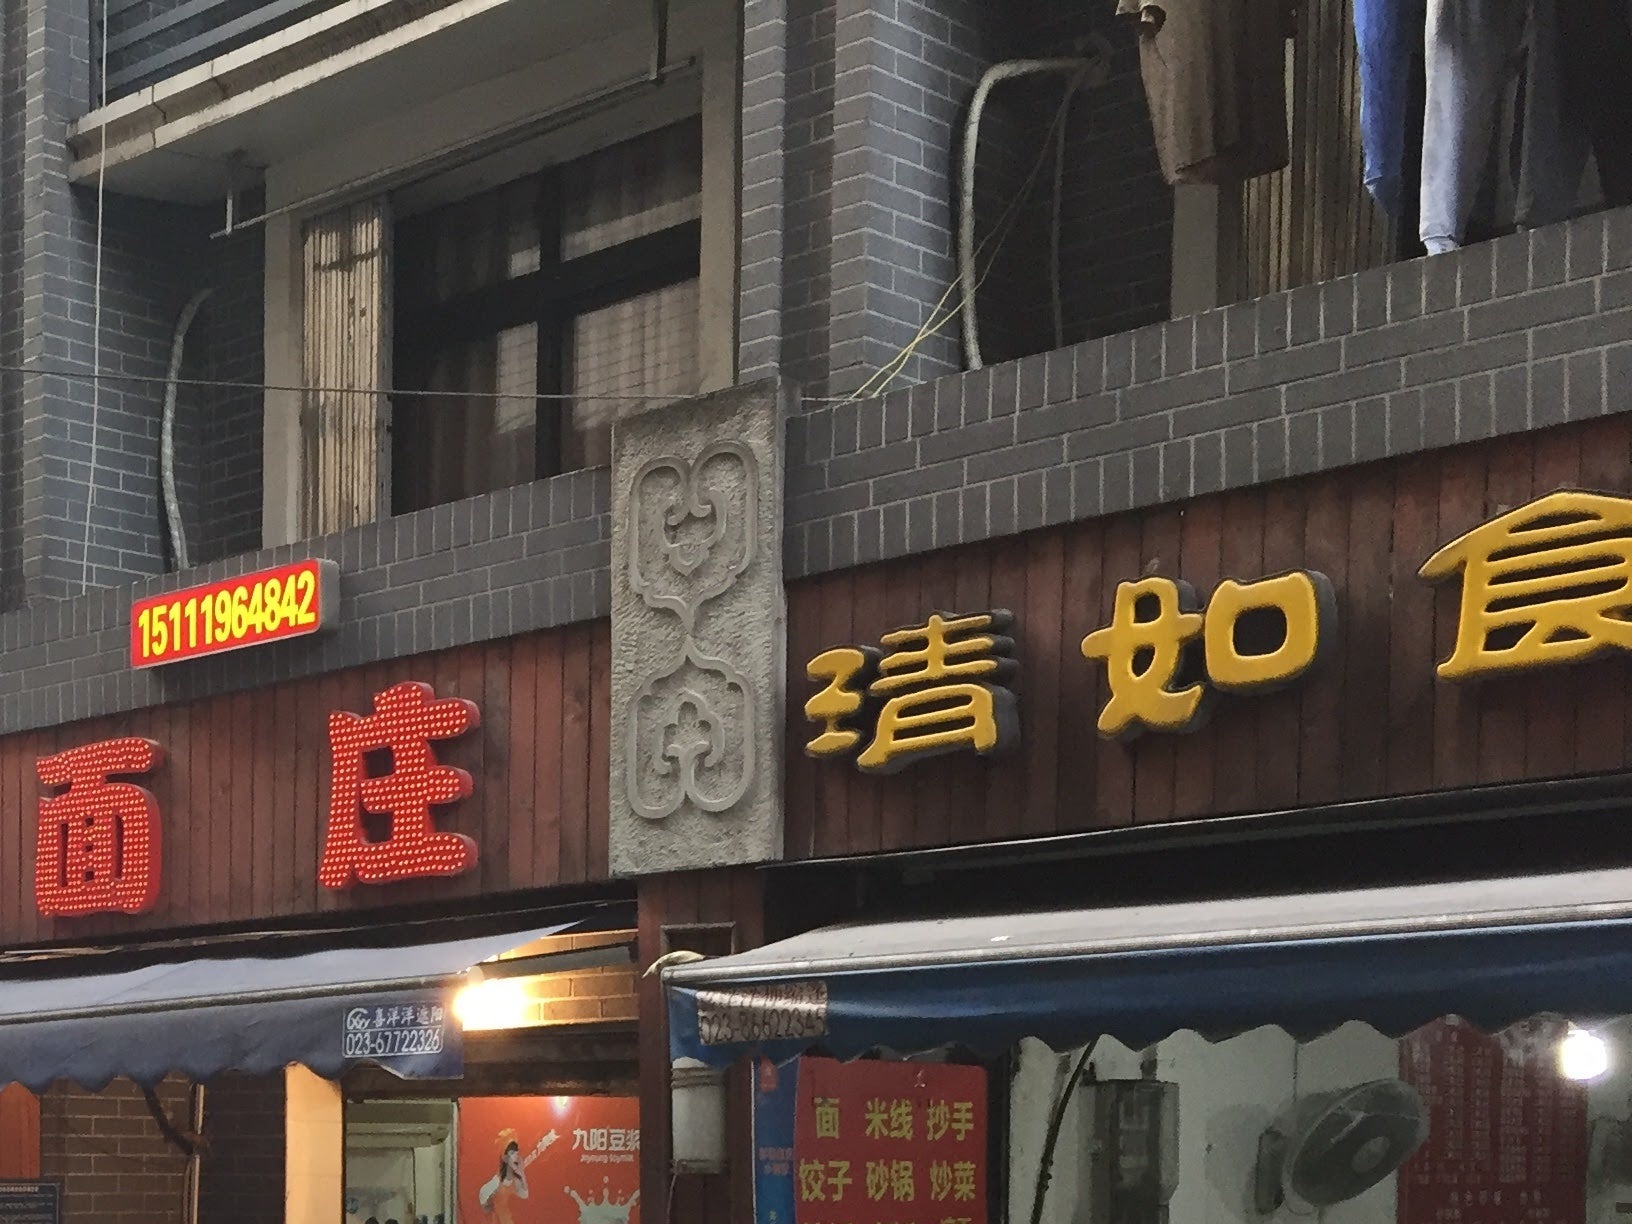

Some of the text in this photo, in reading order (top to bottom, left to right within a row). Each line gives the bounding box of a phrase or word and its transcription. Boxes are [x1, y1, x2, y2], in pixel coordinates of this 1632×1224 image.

[137, 569, 316, 657] 15111964842
[34, 681, 480, 916] 面庄
[346, 1029, 441, 1056] 023-67722326
[814, 1097, 974, 1141] 面 米线 抄手
[799, 1158, 976, 1202] 饺子 砂锅 炒菜
